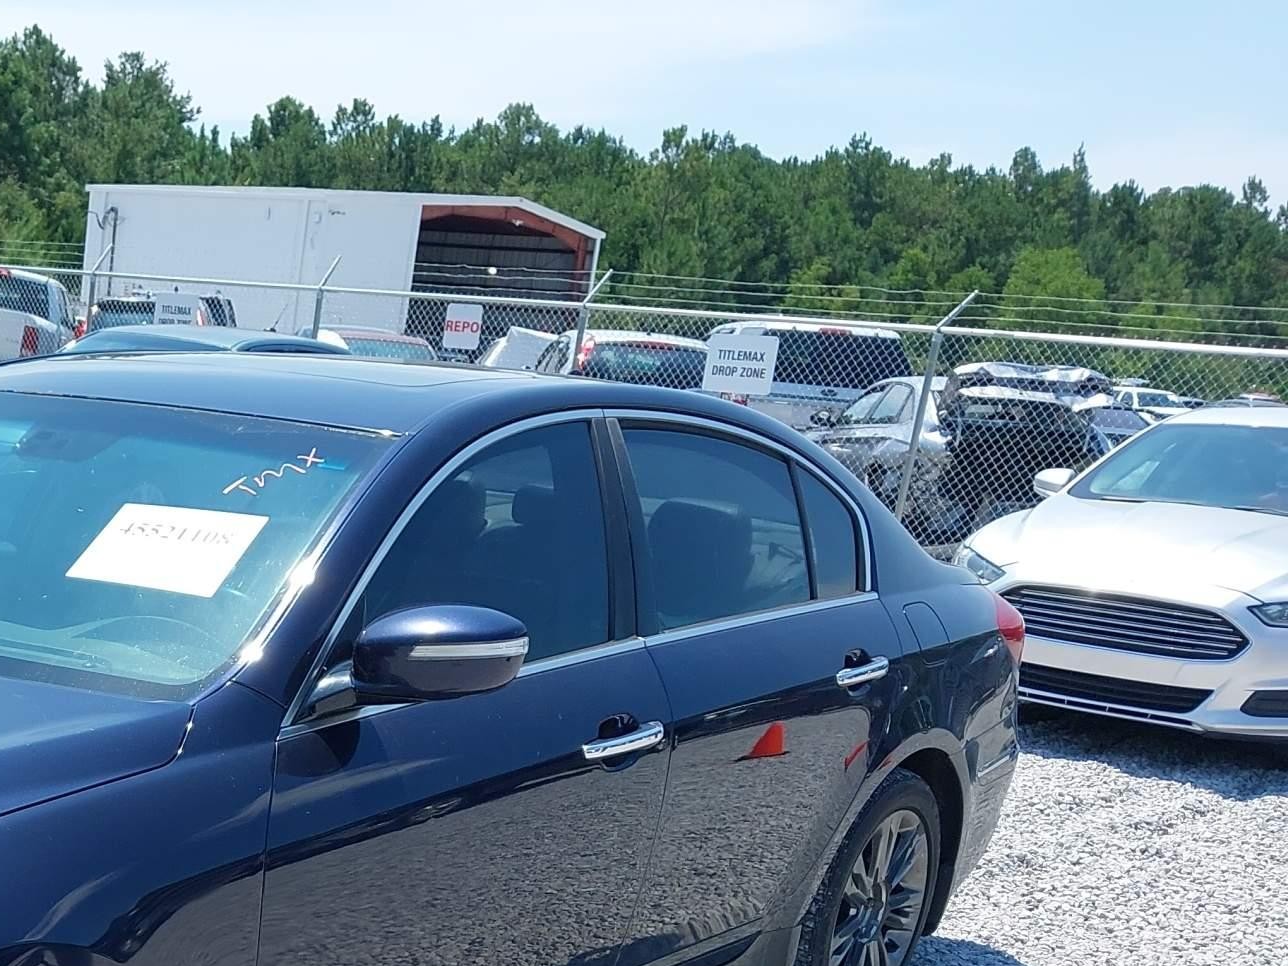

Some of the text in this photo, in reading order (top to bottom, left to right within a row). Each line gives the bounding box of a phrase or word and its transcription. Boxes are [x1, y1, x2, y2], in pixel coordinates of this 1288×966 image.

[162, 304, 192, 315] TITLEMAX
[446, 320, 480, 333] REPO
[718, 349, 766, 362] TITLEMAX
[712, 365, 767, 379] DROP ZONE
[119, 522, 235, 544] 45521108
